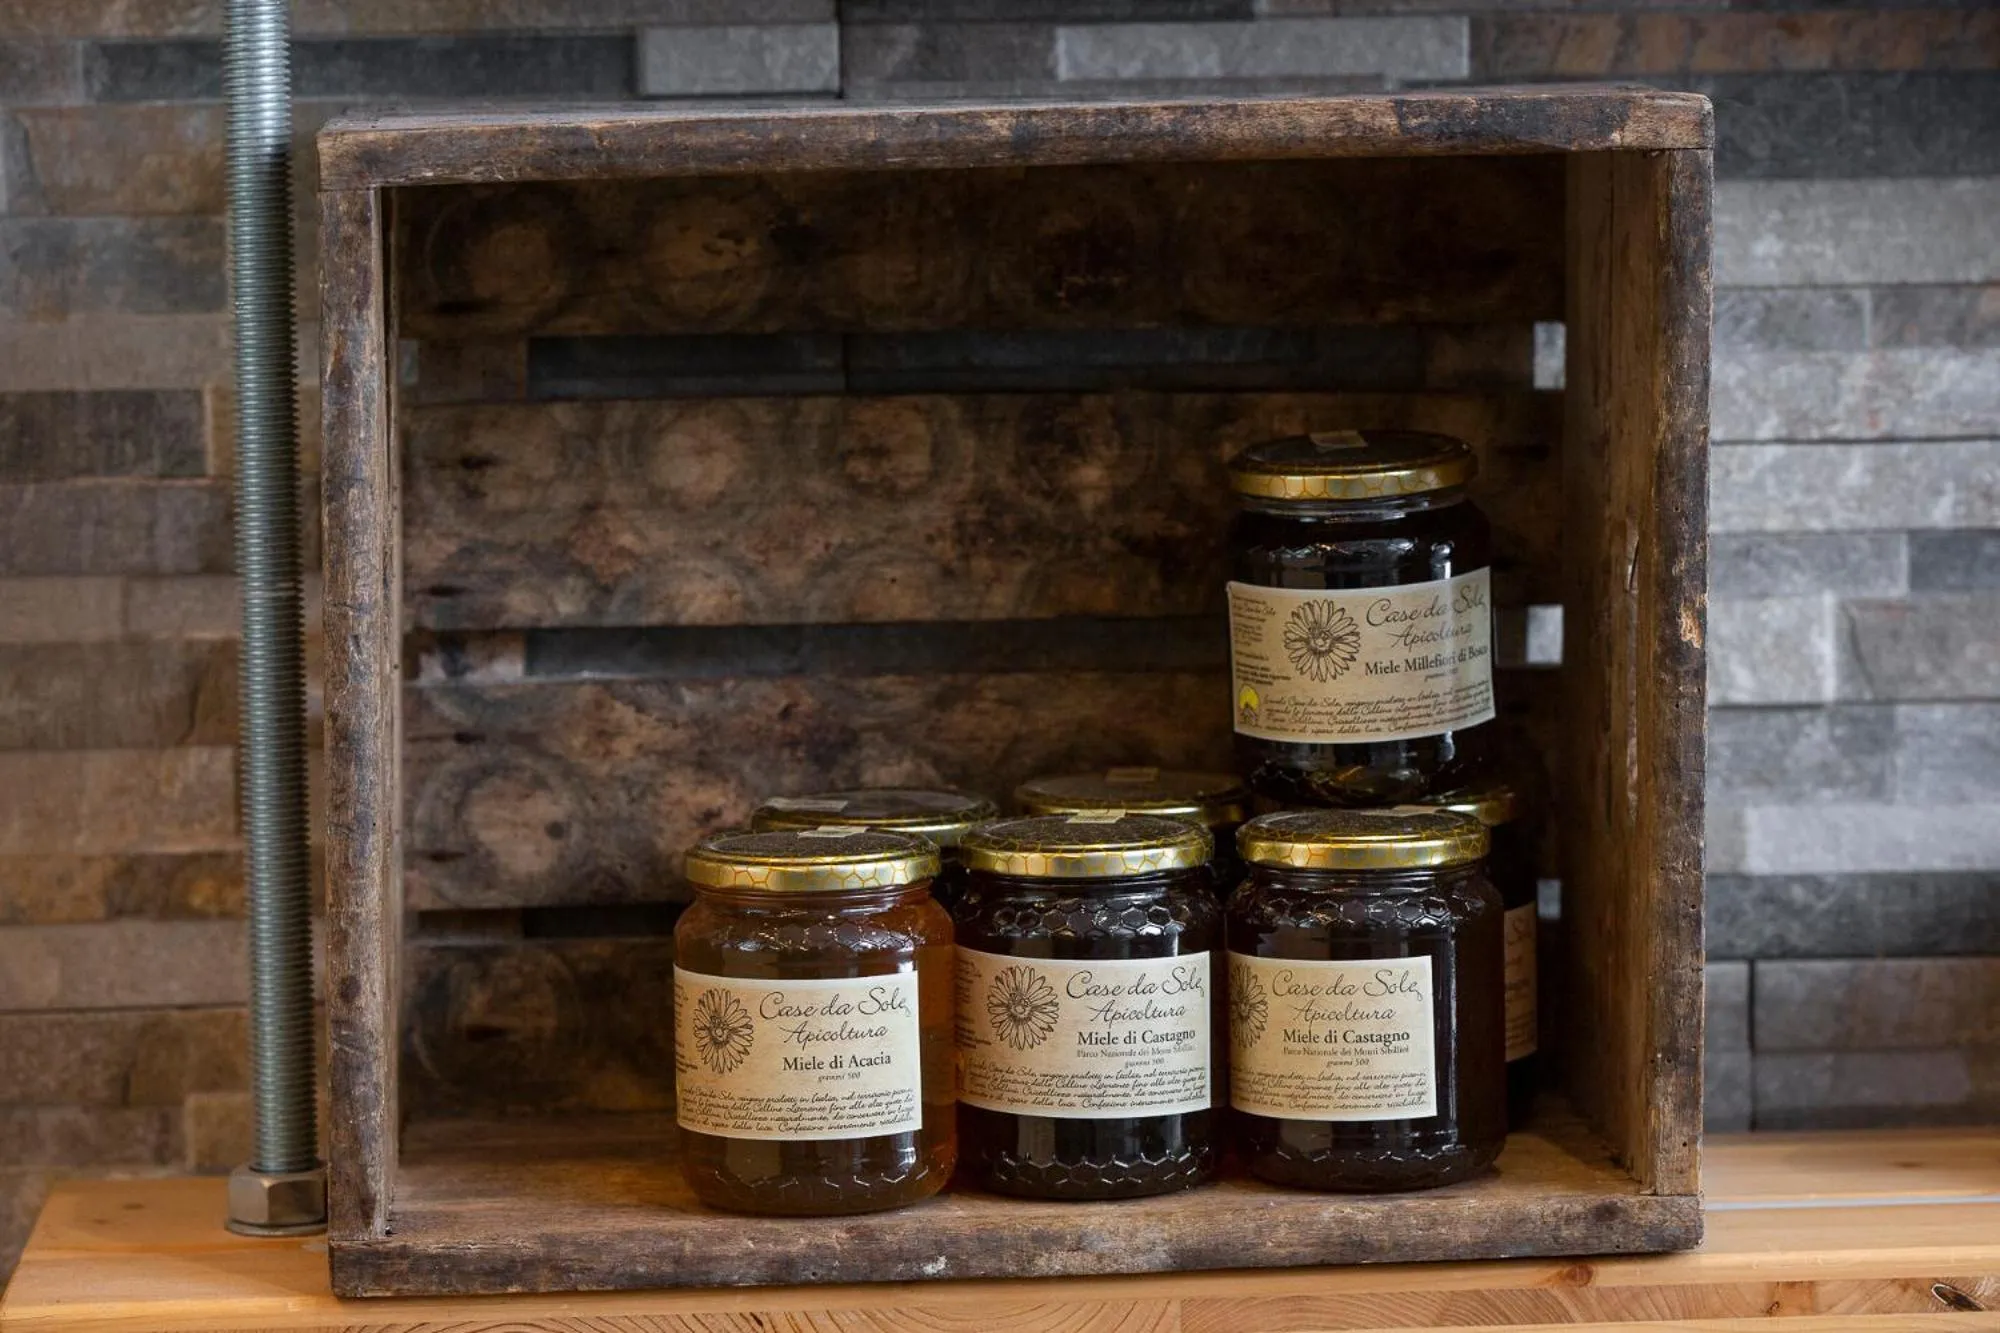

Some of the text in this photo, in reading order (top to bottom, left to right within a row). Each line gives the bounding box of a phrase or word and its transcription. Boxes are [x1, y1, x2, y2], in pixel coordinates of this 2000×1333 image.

[1367, 598, 1420, 626] Case
[1424, 595, 1448, 617] da
[1365, 661, 1400, 676] Miele
[1404, 652, 1456, 672] Millefiori
[1458, 649, 1466, 662] di
[1066, 966, 1204, 998] Case da Sole
[1272, 969, 1423, 1000] Case da Sole
[760, 986, 911, 1020] Case da Sole
[1086, 1000, 1186, 1028] Apicoltura
[1292, 1000, 1396, 1028] Apicoltura
[779, 1021, 888, 1050] Apicoltura
[1077, 1030, 1195, 1045] Miele di Castagno
[1283, 1029, 1410, 1046] Miele di Castagno
[782, 1051, 891, 1070] Miele di Acacia
